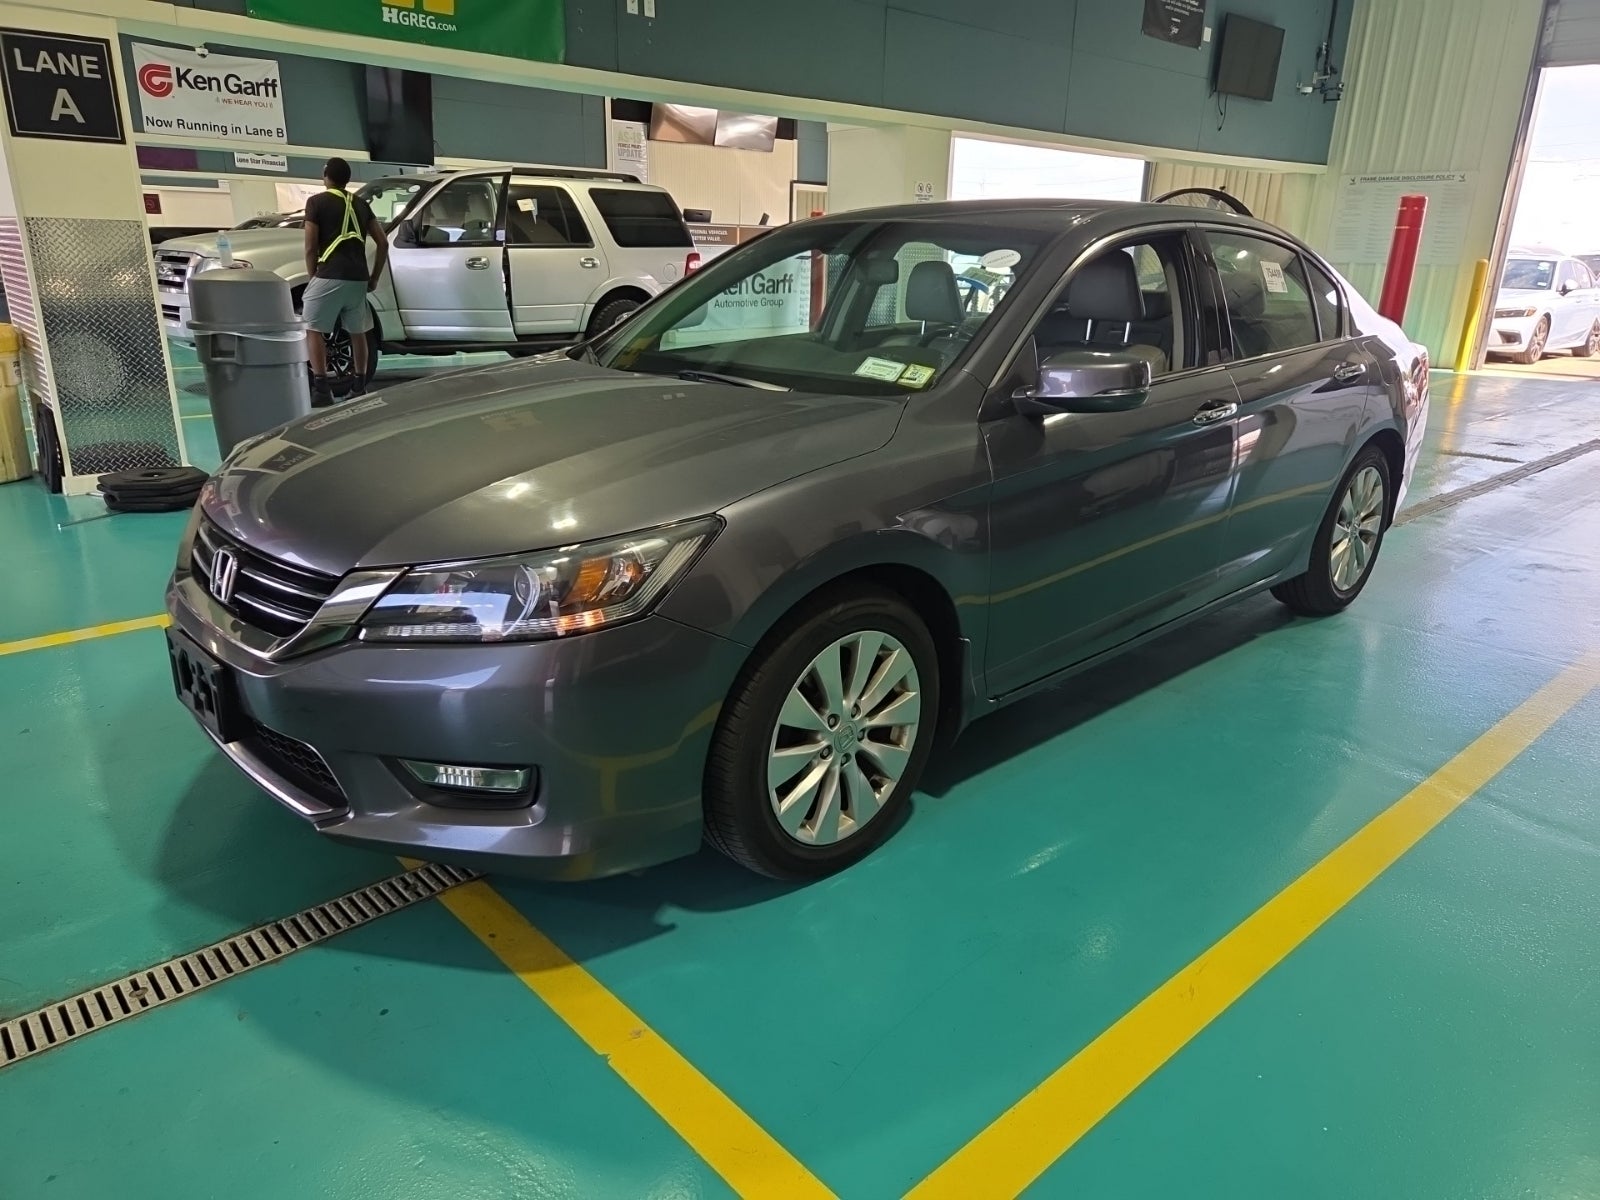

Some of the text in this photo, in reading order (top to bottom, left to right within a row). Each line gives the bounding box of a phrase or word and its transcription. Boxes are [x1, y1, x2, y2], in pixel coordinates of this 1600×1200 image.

[13, 47, 102, 79] LANE
[175, 67, 278, 98] Ken Garff
[50, 88, 86, 124] A
[145, 116, 285, 138] Now Running in Lane B
[250, 157, 261, 165] Star
[262, 158, 286, 167] Financial
[617, 148, 643, 159] UPDATE
[751, 272, 793, 295] Garff
[714, 297, 784, 308] Automotive Group
